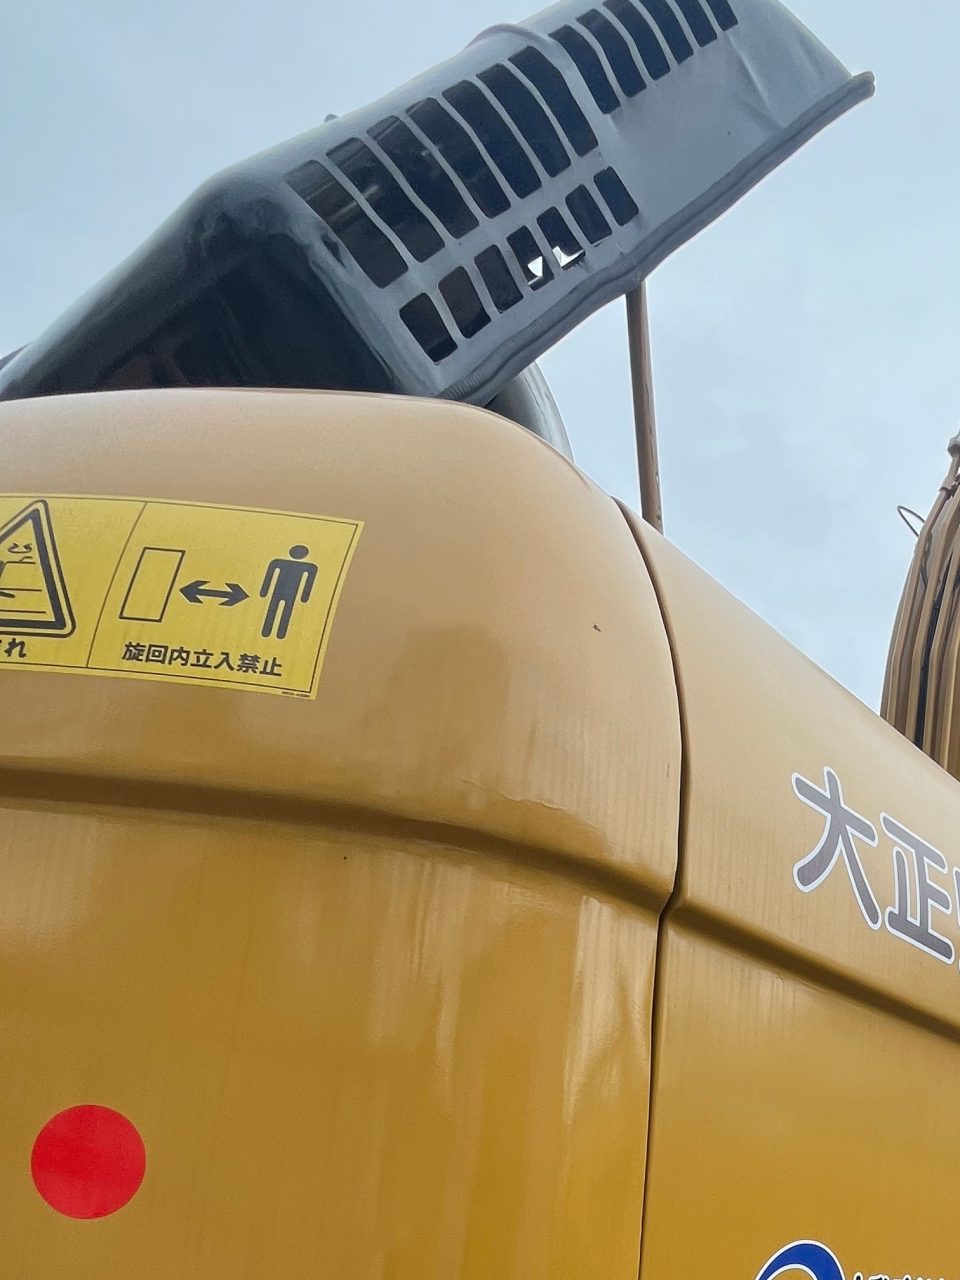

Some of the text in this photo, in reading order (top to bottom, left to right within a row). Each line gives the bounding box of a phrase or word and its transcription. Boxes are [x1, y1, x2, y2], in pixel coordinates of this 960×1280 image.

[122, 641, 283, 677] 旋回内立入禁止
